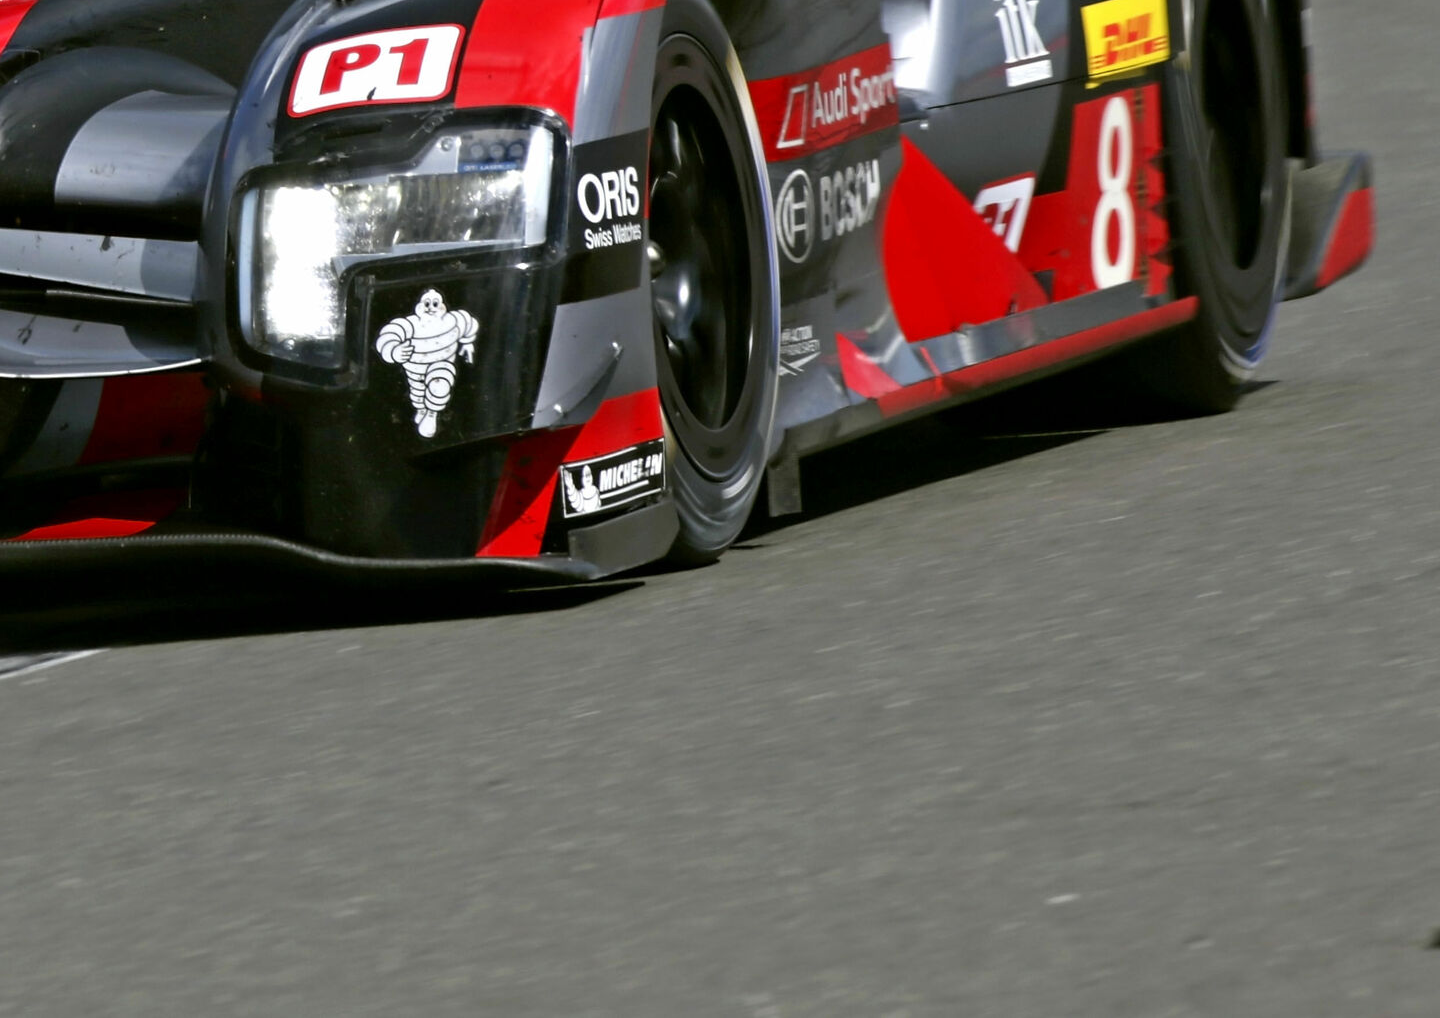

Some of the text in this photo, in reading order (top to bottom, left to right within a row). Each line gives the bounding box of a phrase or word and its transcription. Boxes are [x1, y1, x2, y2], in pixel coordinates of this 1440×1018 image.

[320, 38, 429, 95] P1
[811, 67, 896, 128] Audi Sport
[577, 166, 640, 224] ORIS
[819, 159, 880, 241] BOSCH
[1091, 96, 1136, 290] 8
[584, 222, 642, 250] Swiss Watches
